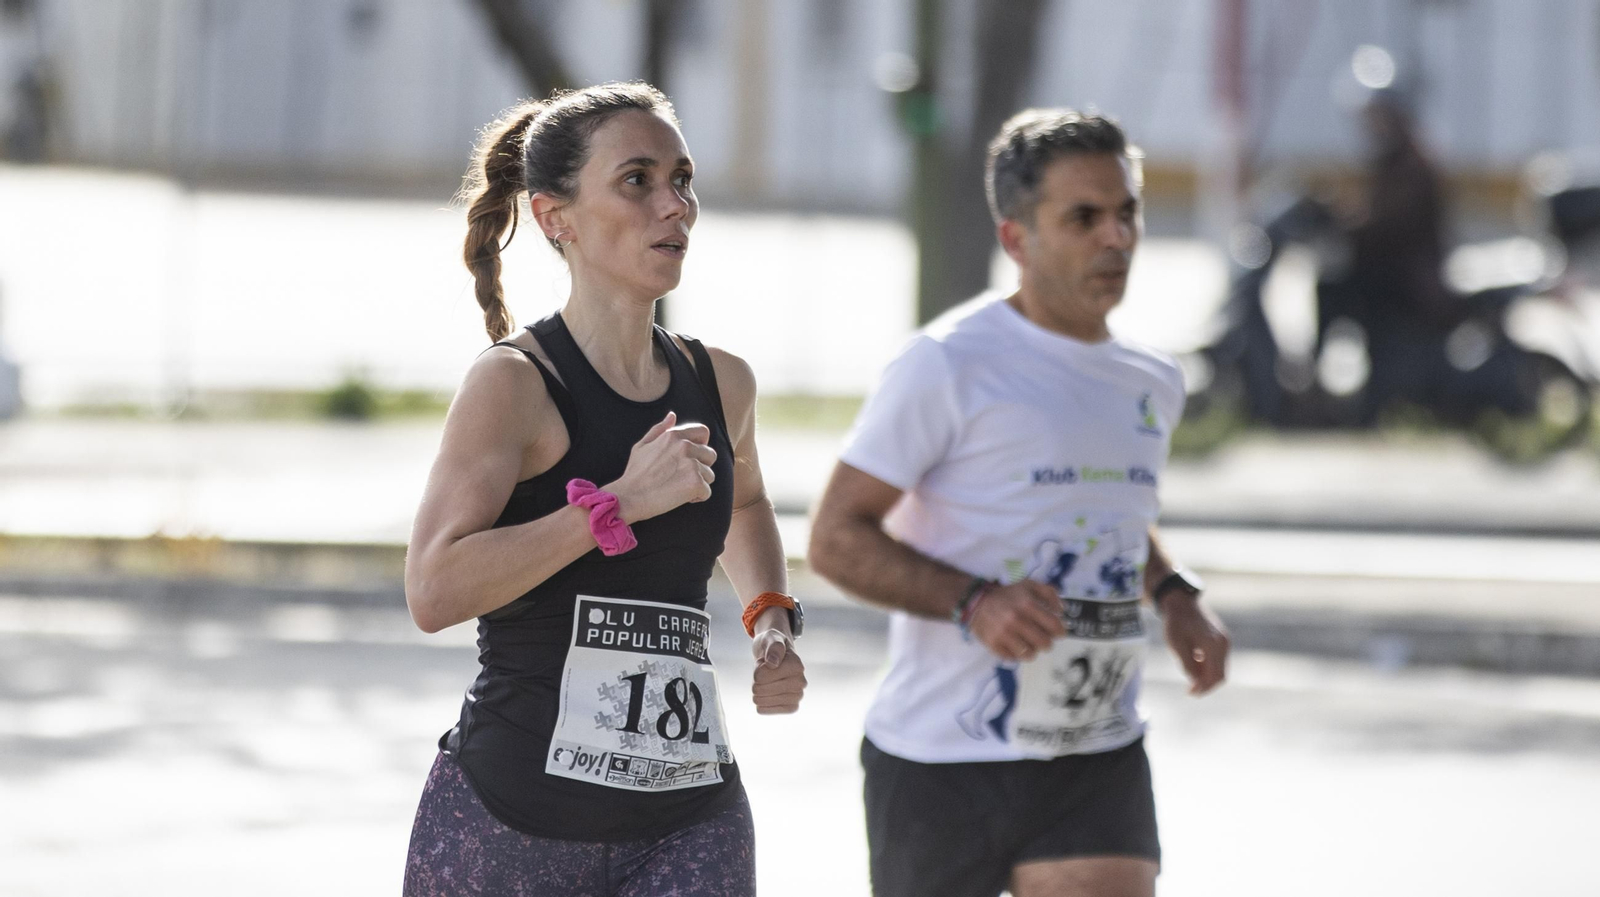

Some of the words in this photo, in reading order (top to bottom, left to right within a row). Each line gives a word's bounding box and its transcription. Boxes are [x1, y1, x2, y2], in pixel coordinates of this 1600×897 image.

[588, 608, 635, 627] LV
[586, 628, 681, 652] POPULAR
[615, 672, 710, 745] 182
[553, 746, 608, 776] ejoy!
